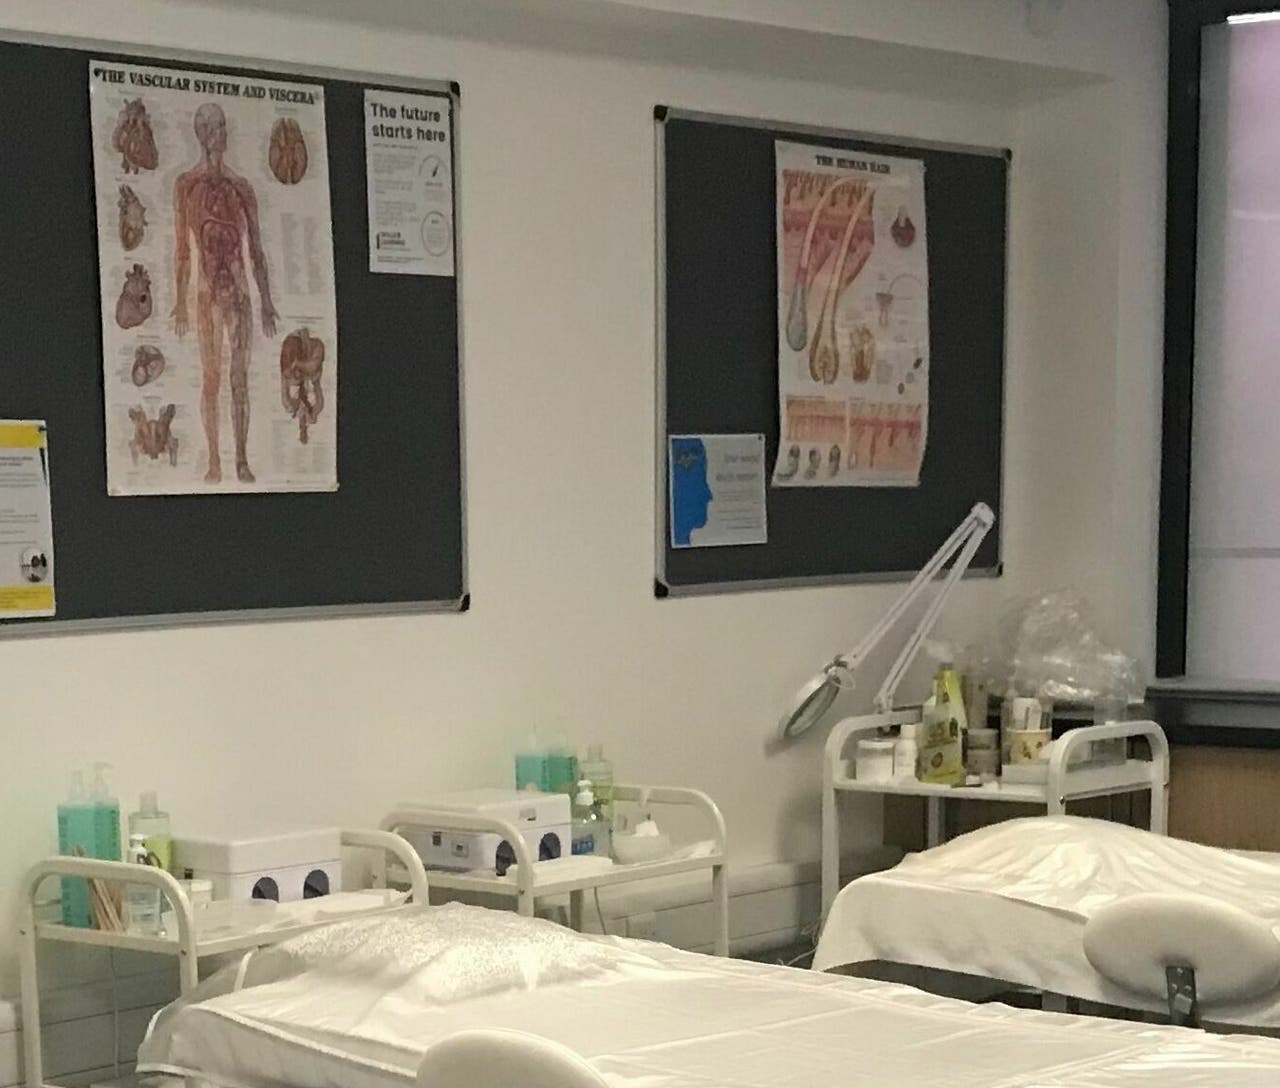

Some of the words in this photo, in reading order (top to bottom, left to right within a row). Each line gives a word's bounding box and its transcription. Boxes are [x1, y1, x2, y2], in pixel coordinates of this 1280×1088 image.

[101, 69, 126, 84] THE
[129, 72, 190, 91] VASCULAR
[194, 79, 239, 97] SYSTEM
[242, 85, 265, 99] AND
[268, 87, 315, 105] VISCERA
[370, 102, 397, 120] The
[400, 103, 441, 124] future
[371, 123, 414, 141] starts
[416, 126, 447, 143] here
